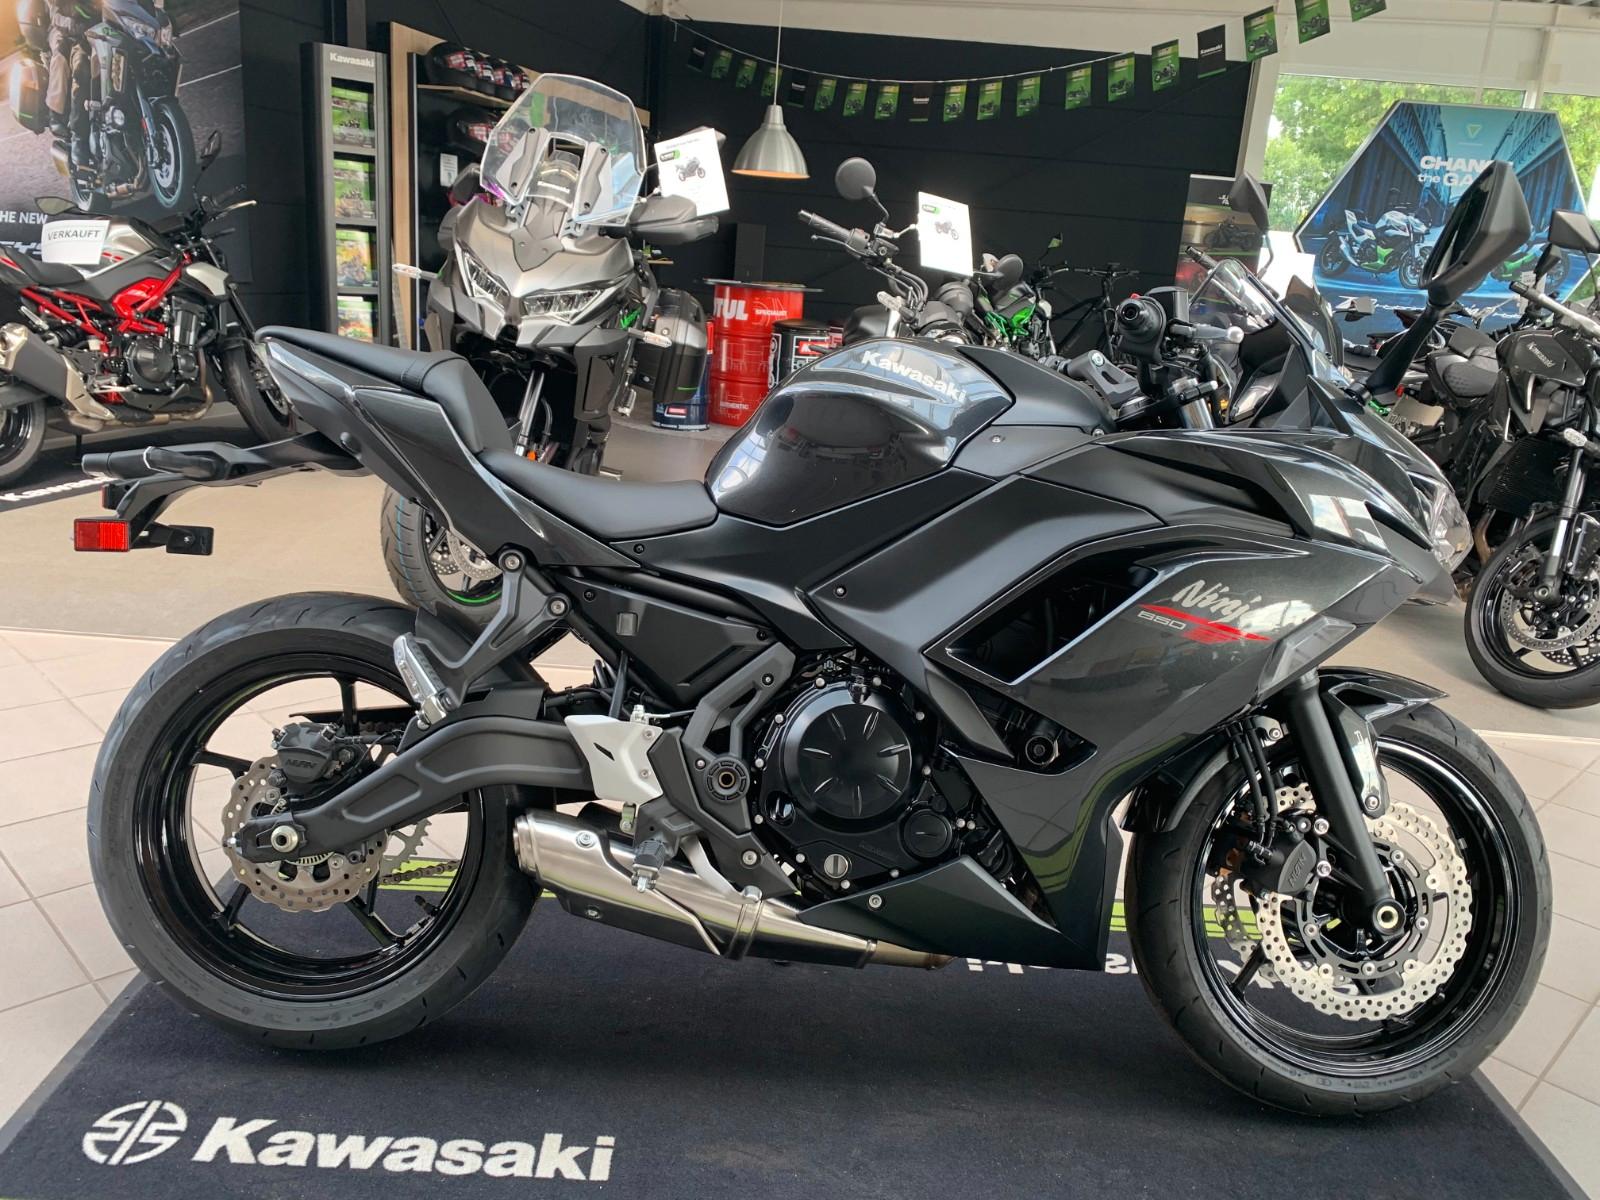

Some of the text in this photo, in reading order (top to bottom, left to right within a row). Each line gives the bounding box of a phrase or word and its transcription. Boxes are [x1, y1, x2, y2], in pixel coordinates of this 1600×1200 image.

[330, 52, 375, 68] Kawasaki
[1420, 155, 1514, 173] CHAN
[1418, 172, 1477, 187] the GA
[0, 210, 48, 224] HE NEW
[48, 229, 101, 241] VERKAUFT
[714, 297, 749, 321] TUL
[861, 350, 967, 403] Kawasaki
[1171, 580, 1268, 625] Ninj
[1137, 610, 1187, 630] 650
[191, 1117, 616, 1182] Kawasaki
